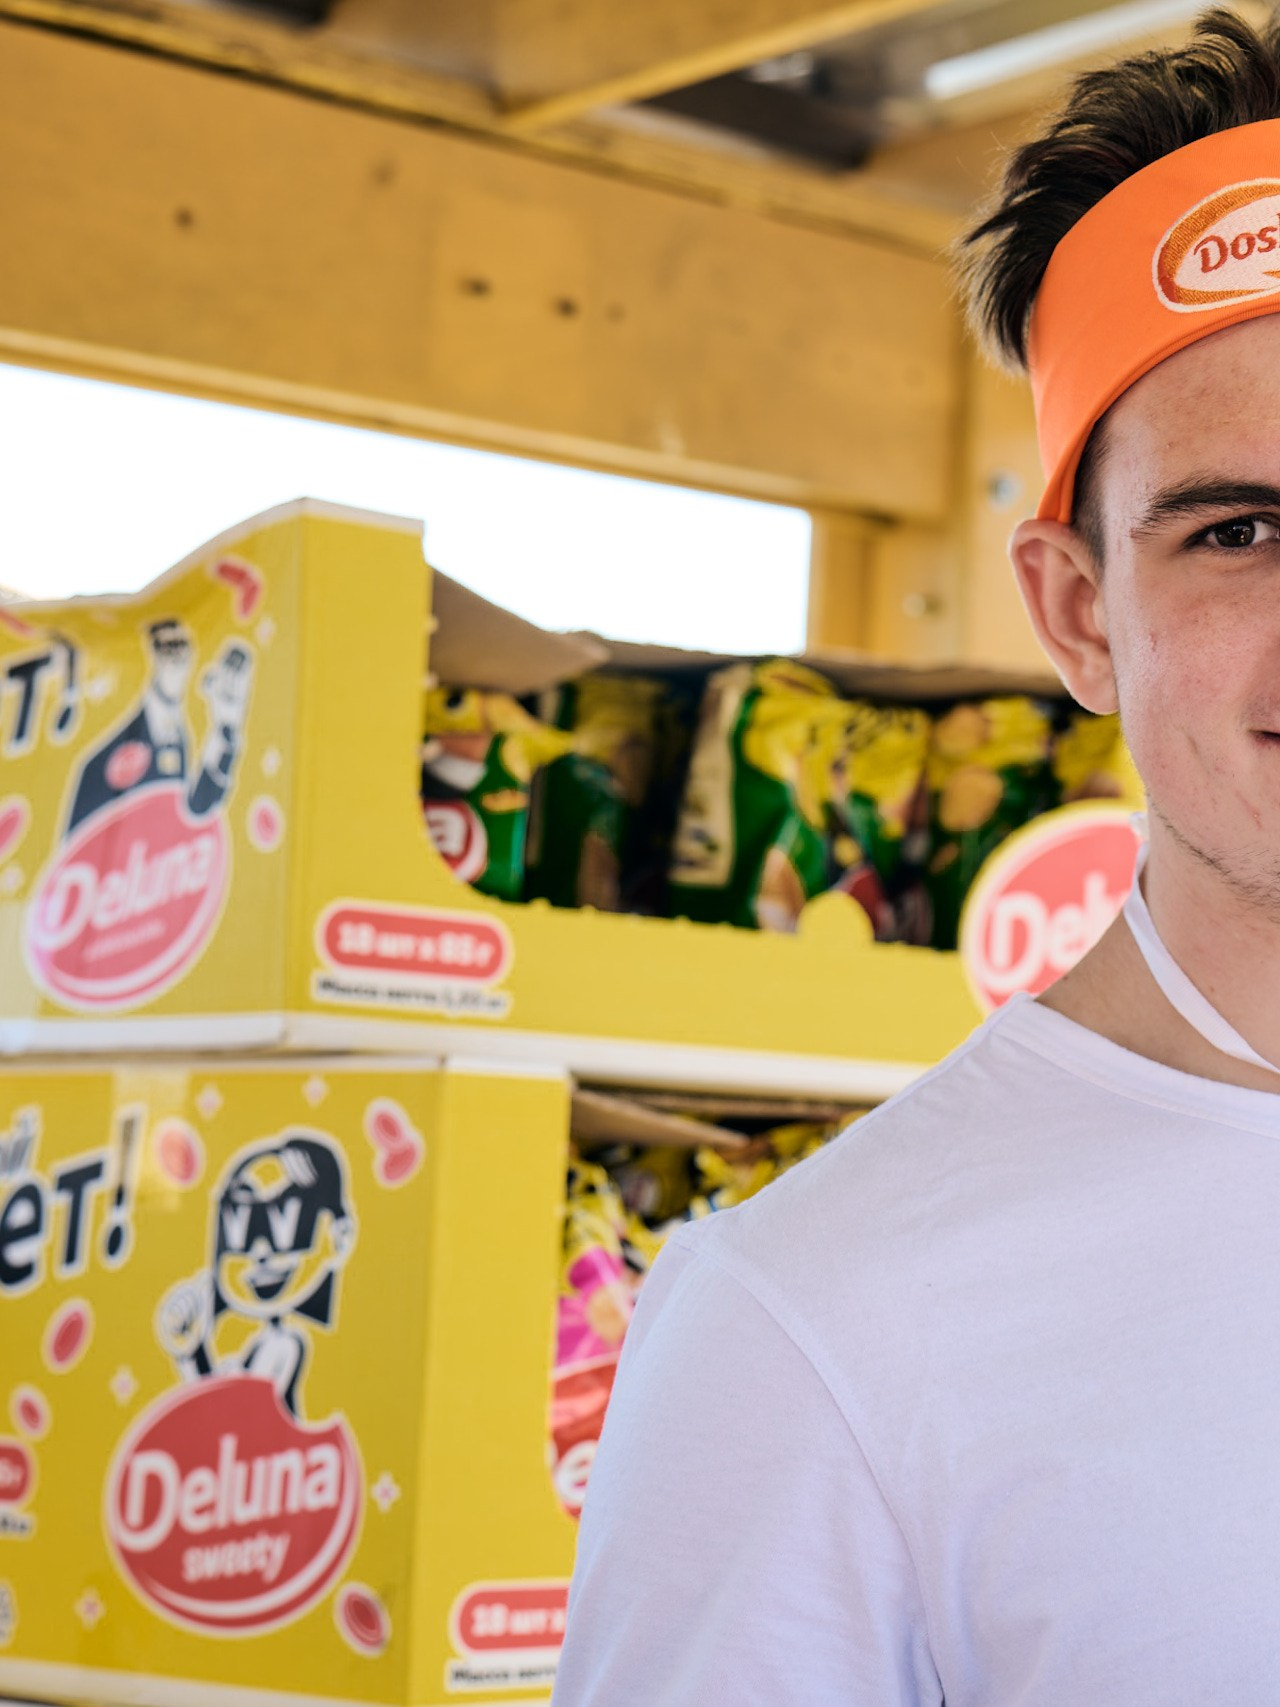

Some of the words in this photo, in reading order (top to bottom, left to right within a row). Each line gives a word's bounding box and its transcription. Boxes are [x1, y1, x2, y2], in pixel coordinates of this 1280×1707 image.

[33, 837, 212, 948] Deluna
[976, 872, 1131, 992] Del
[118, 1433, 341, 1552] Deluna
[183, 1532, 291, 1583] sweety
